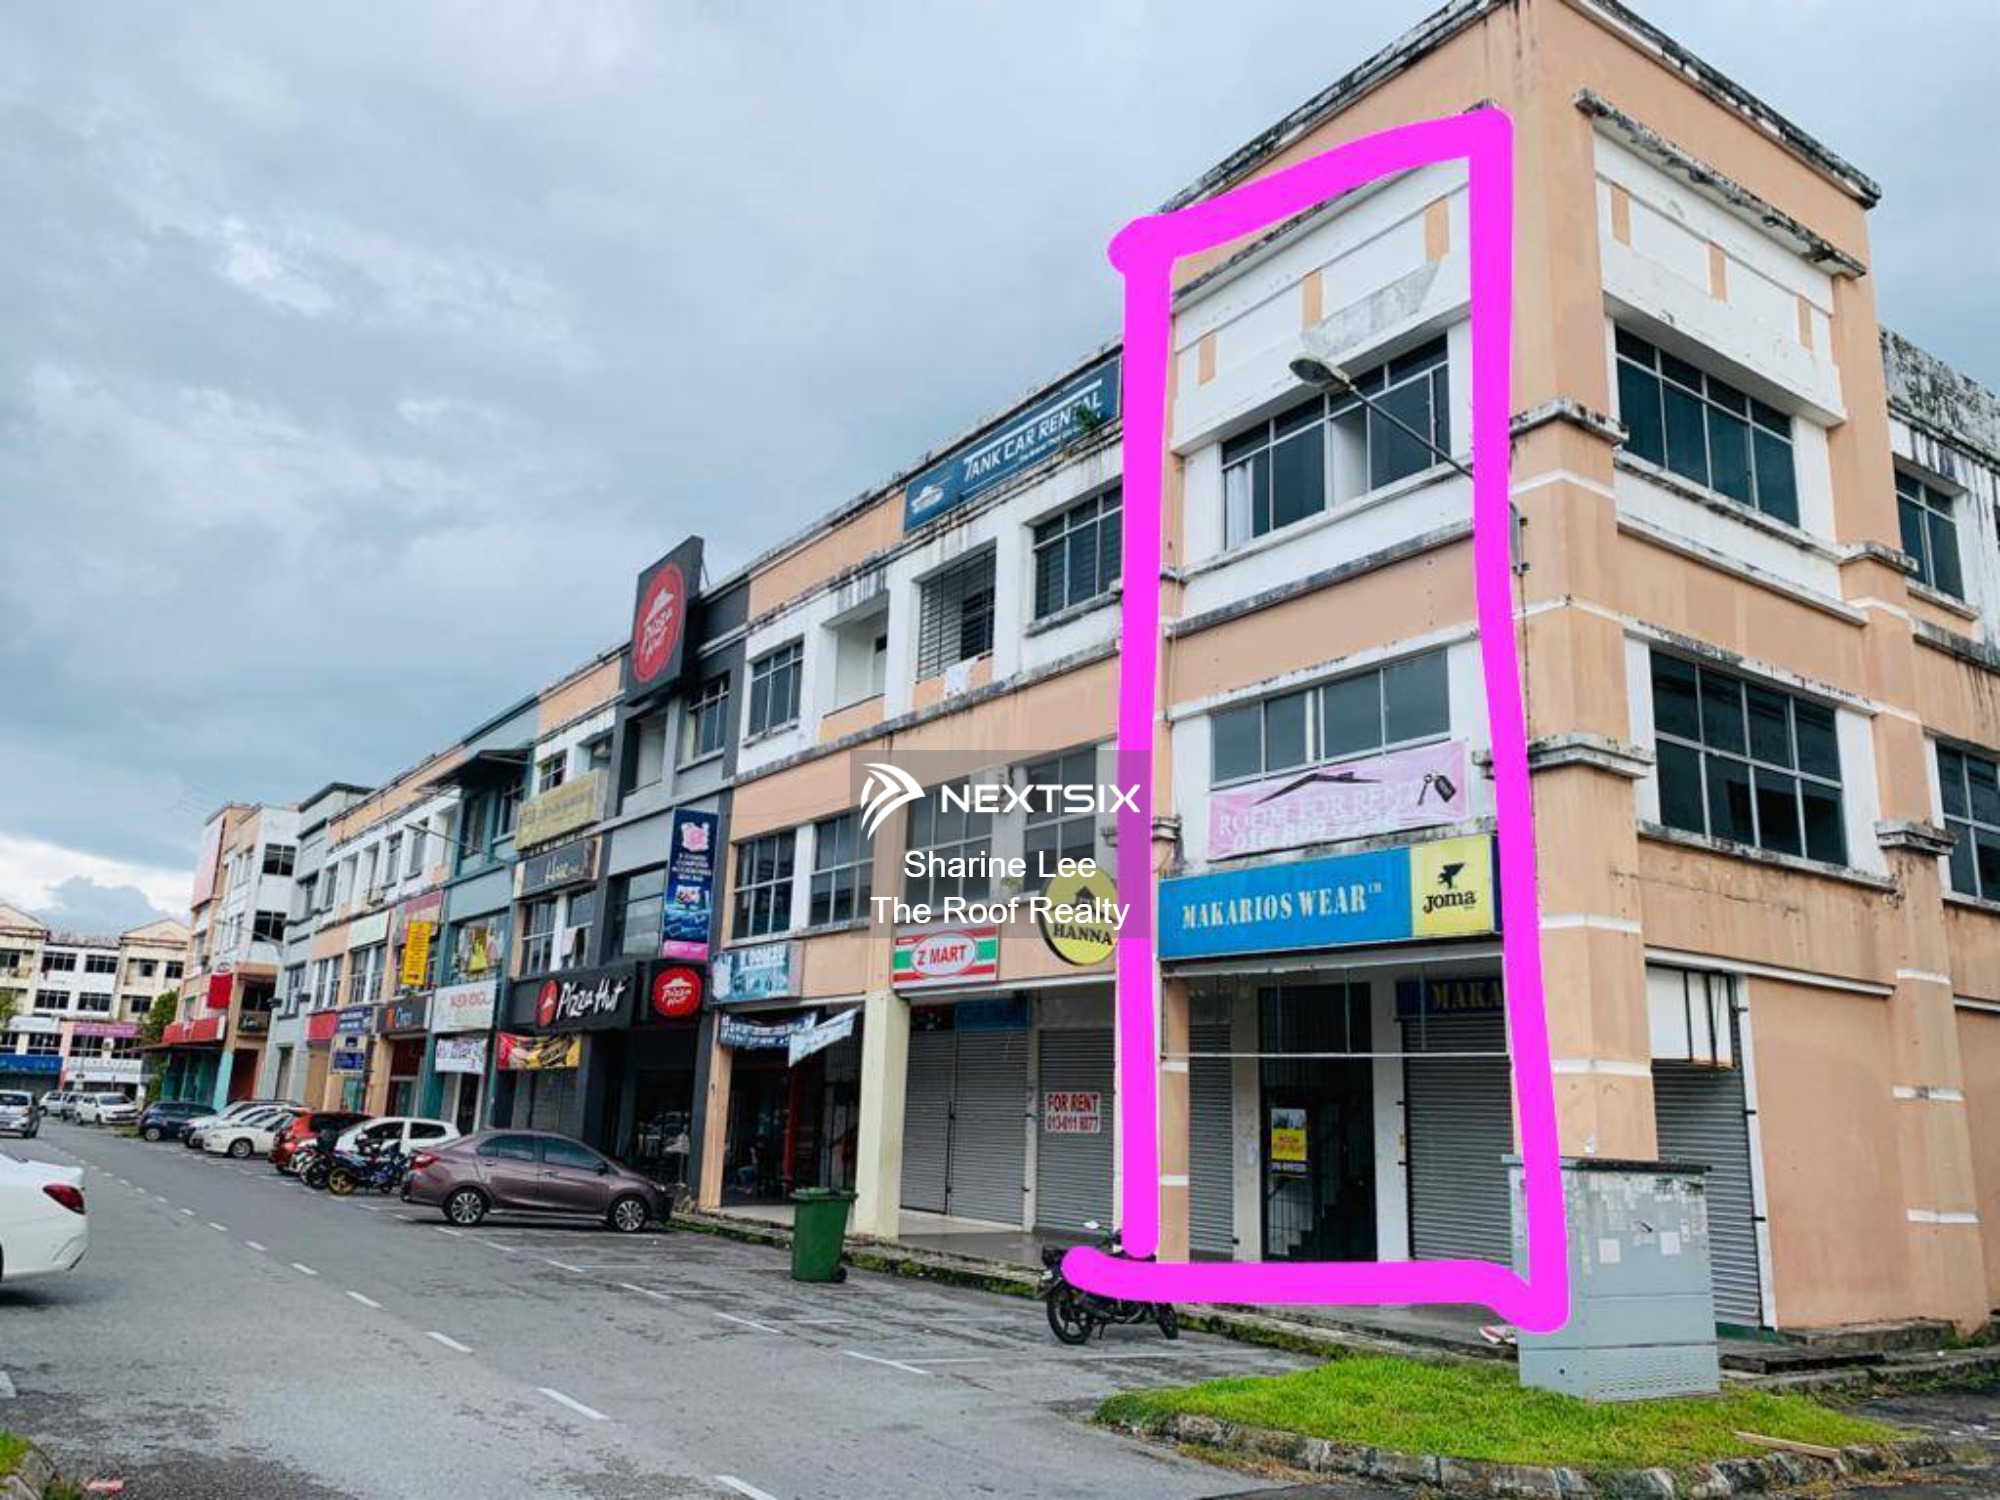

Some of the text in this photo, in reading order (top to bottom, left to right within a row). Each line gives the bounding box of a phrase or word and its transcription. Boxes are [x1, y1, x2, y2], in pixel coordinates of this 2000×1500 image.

[963, 449, 1002, 482] TANK
[1003, 430, 1036, 460] CAR
[1182, 893, 1294, 930] MAKARIOS
[1297, 885, 1368, 919] WEAR
[1052, 921, 1114, 947] HANNA
[916, 944, 967, 966] Z MART
[556, 976, 626, 1020] Pizza Hut
[1048, 1094, 1098, 1112] FOR RENT
